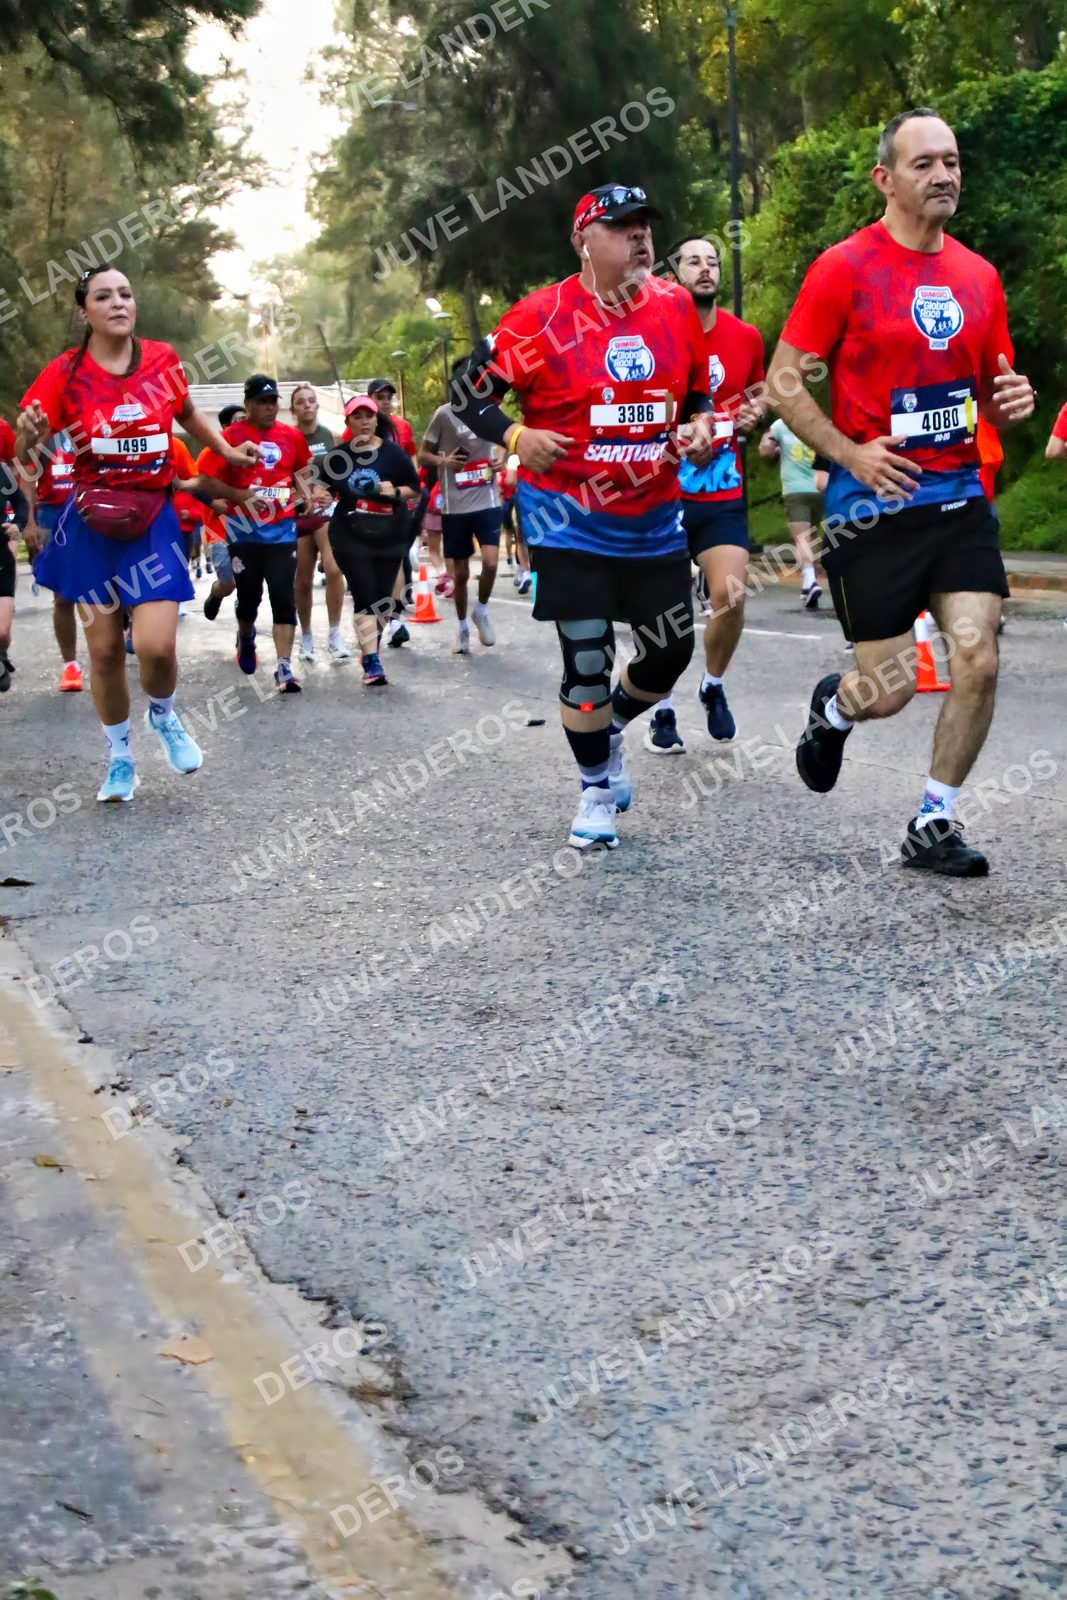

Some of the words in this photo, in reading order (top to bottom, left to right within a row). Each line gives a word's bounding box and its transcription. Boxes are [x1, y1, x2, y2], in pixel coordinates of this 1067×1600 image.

[618, 404, 654, 423] 3386
[922, 408, 959, 431] 4080
[117, 438, 147, 453] 1499
